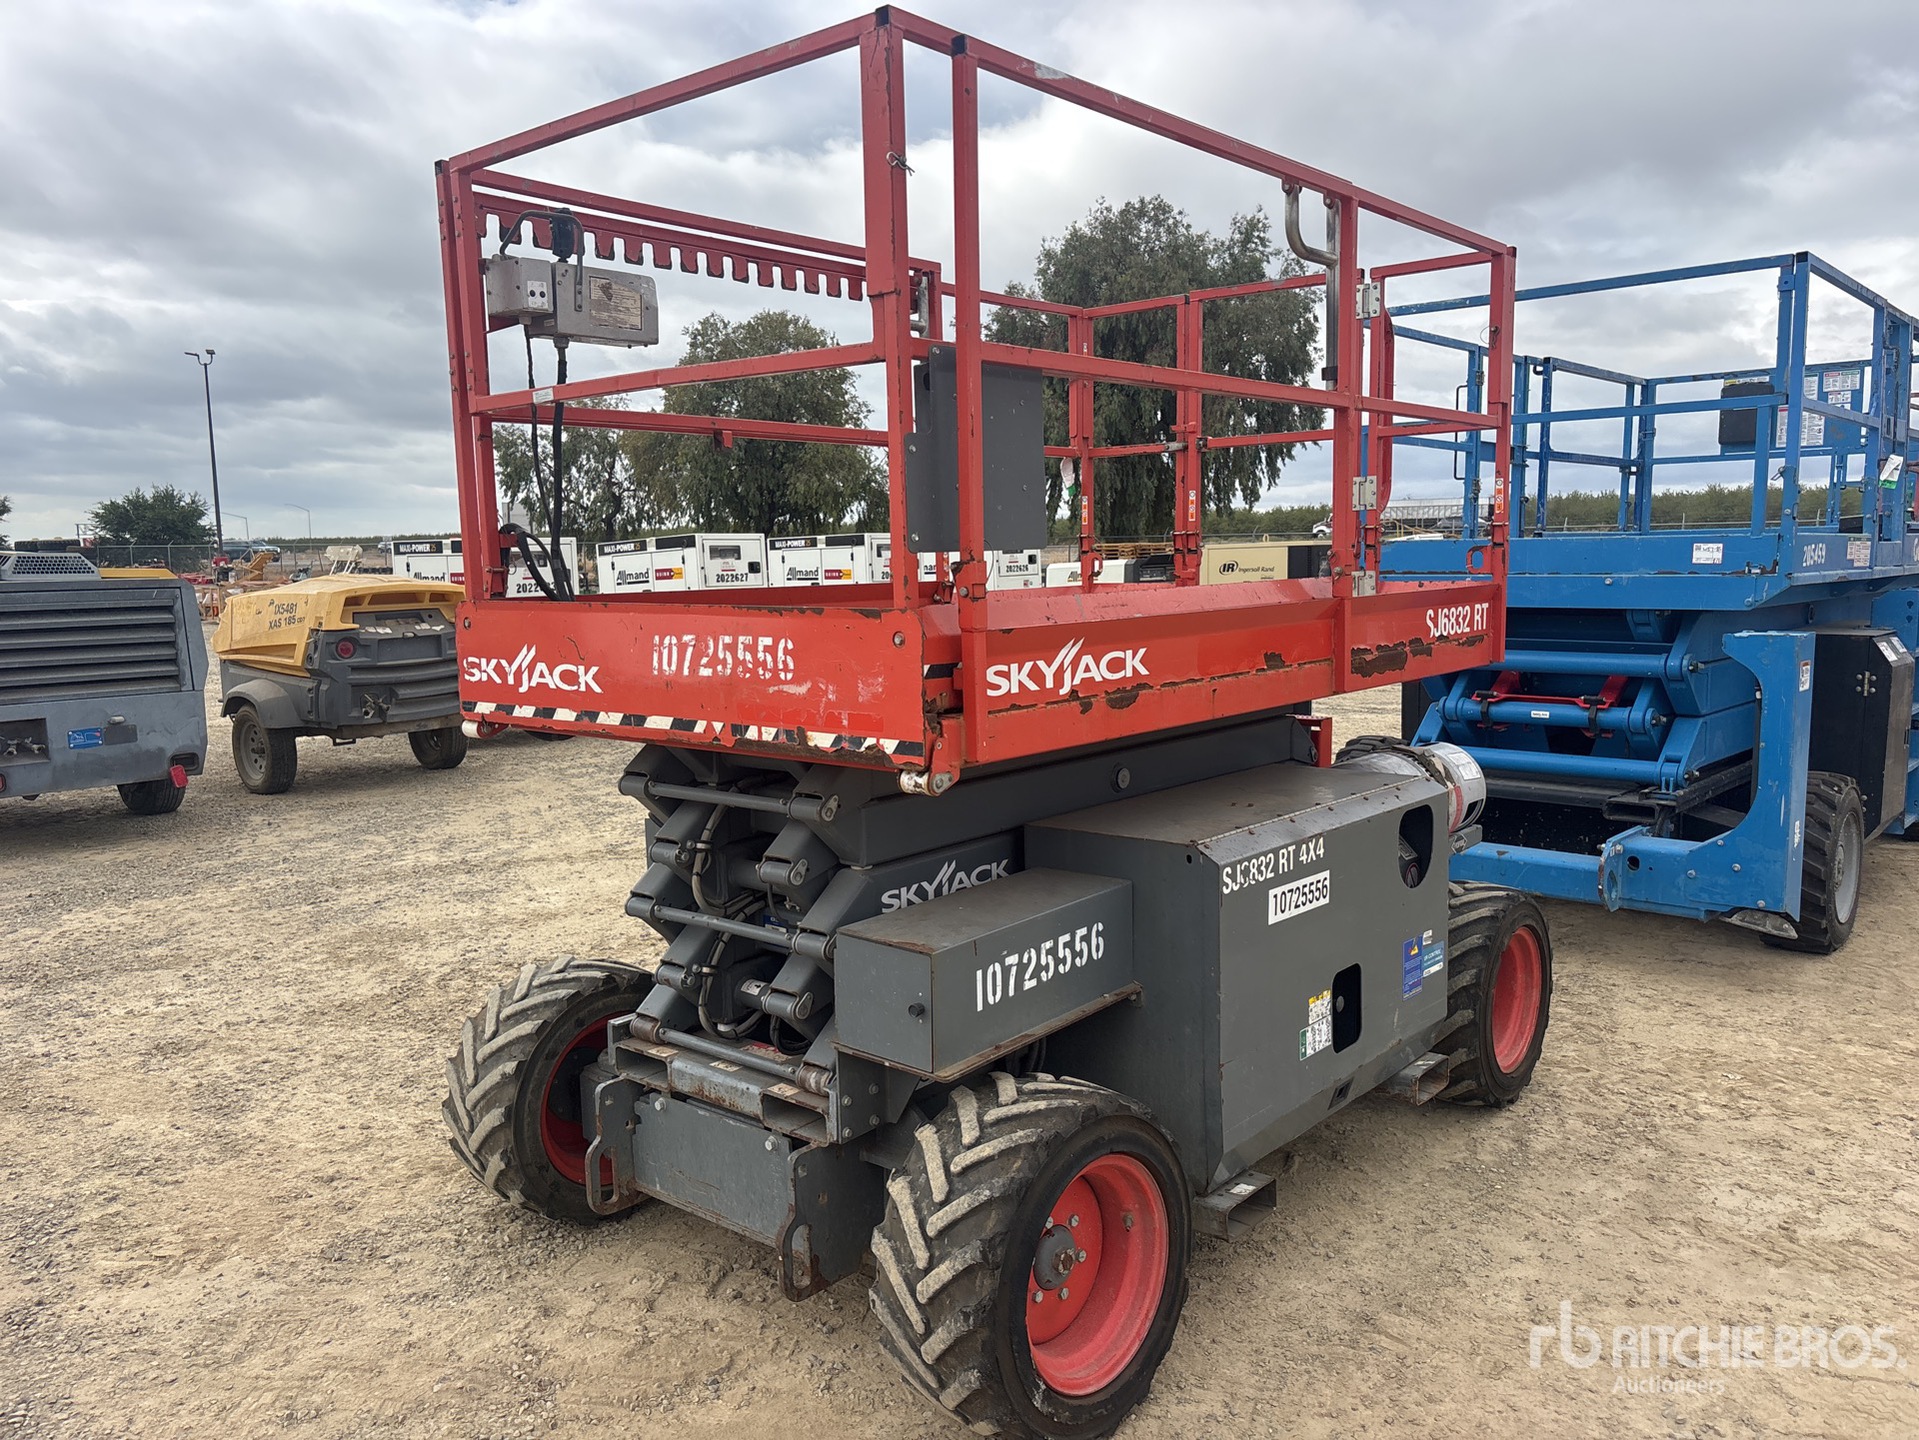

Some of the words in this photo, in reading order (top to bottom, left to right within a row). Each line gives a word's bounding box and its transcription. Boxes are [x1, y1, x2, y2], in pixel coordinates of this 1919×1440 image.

[604, 543, 635, 553] MAXI-POWER
[616, 568, 650, 584] Allmand
[715, 572, 749, 583] 2022627
[786, 567, 819, 580] Allmand
[1221, 562, 1236, 573] IR
[1238, 566, 1260, 574] Ingersoll
[284, 614, 296, 626] 185
[1426, 605, 1471, 638] SJ6832
[1474, 602, 1489, 631] RT
[463, 643, 604, 694] SKYJACK
[651, 634, 794, 681] 10725556
[985, 637, 1150, 697] SKYJACK
[1278, 844, 1296, 874] RT
[1299, 836, 1325, 864] 4X4
[880, 859, 1011, 914] SKYJACK
[1273, 876, 1329, 916] 10725556
[975, 921, 1105, 1012] 10725556
